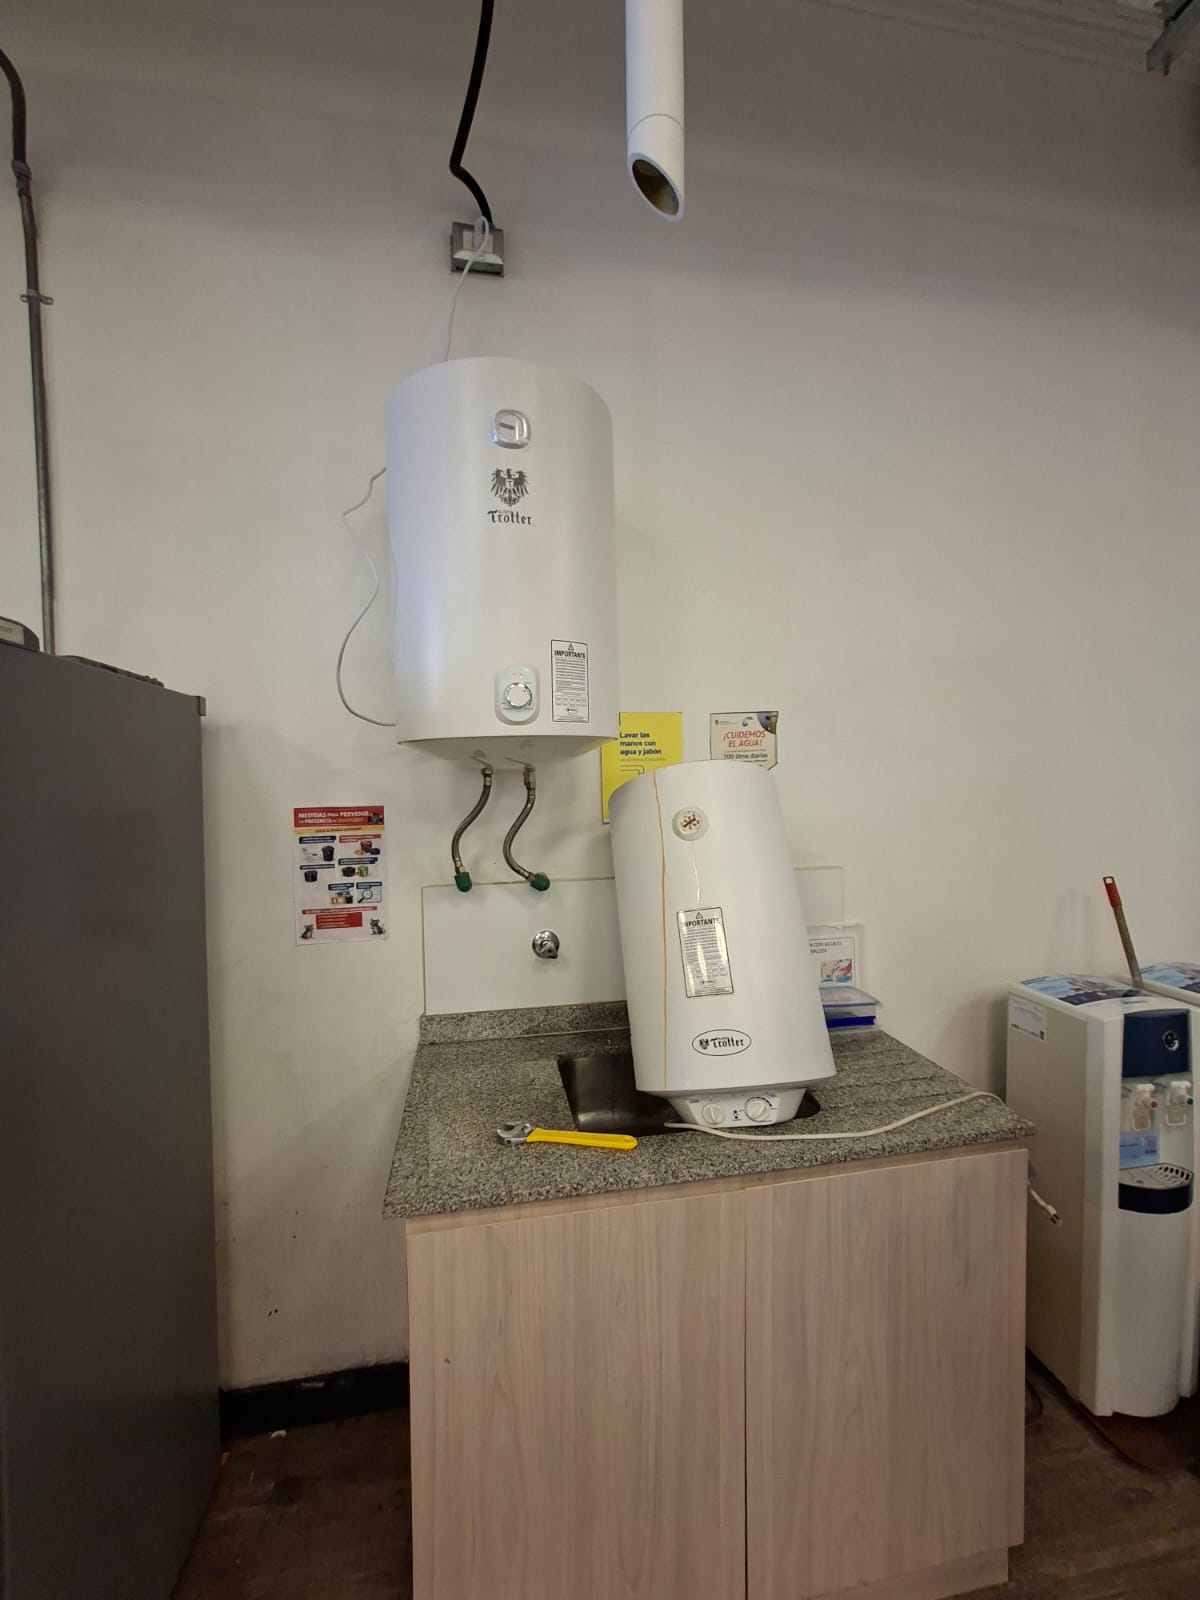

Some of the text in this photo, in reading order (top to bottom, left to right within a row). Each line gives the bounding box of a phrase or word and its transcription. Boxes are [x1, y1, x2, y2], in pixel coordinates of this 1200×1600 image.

[486, 509, 532, 525] Trotter
[554, 649, 586, 659] IMPORTANTE
[619, 731, 650, 739] Lavar las
[723, 730, 766, 741] ¡CUIDEMOS
[728, 739, 763, 748] EL AGUA!
[643, 748, 662, 756] jabón
[710, 1036, 744, 1048] Trotter
